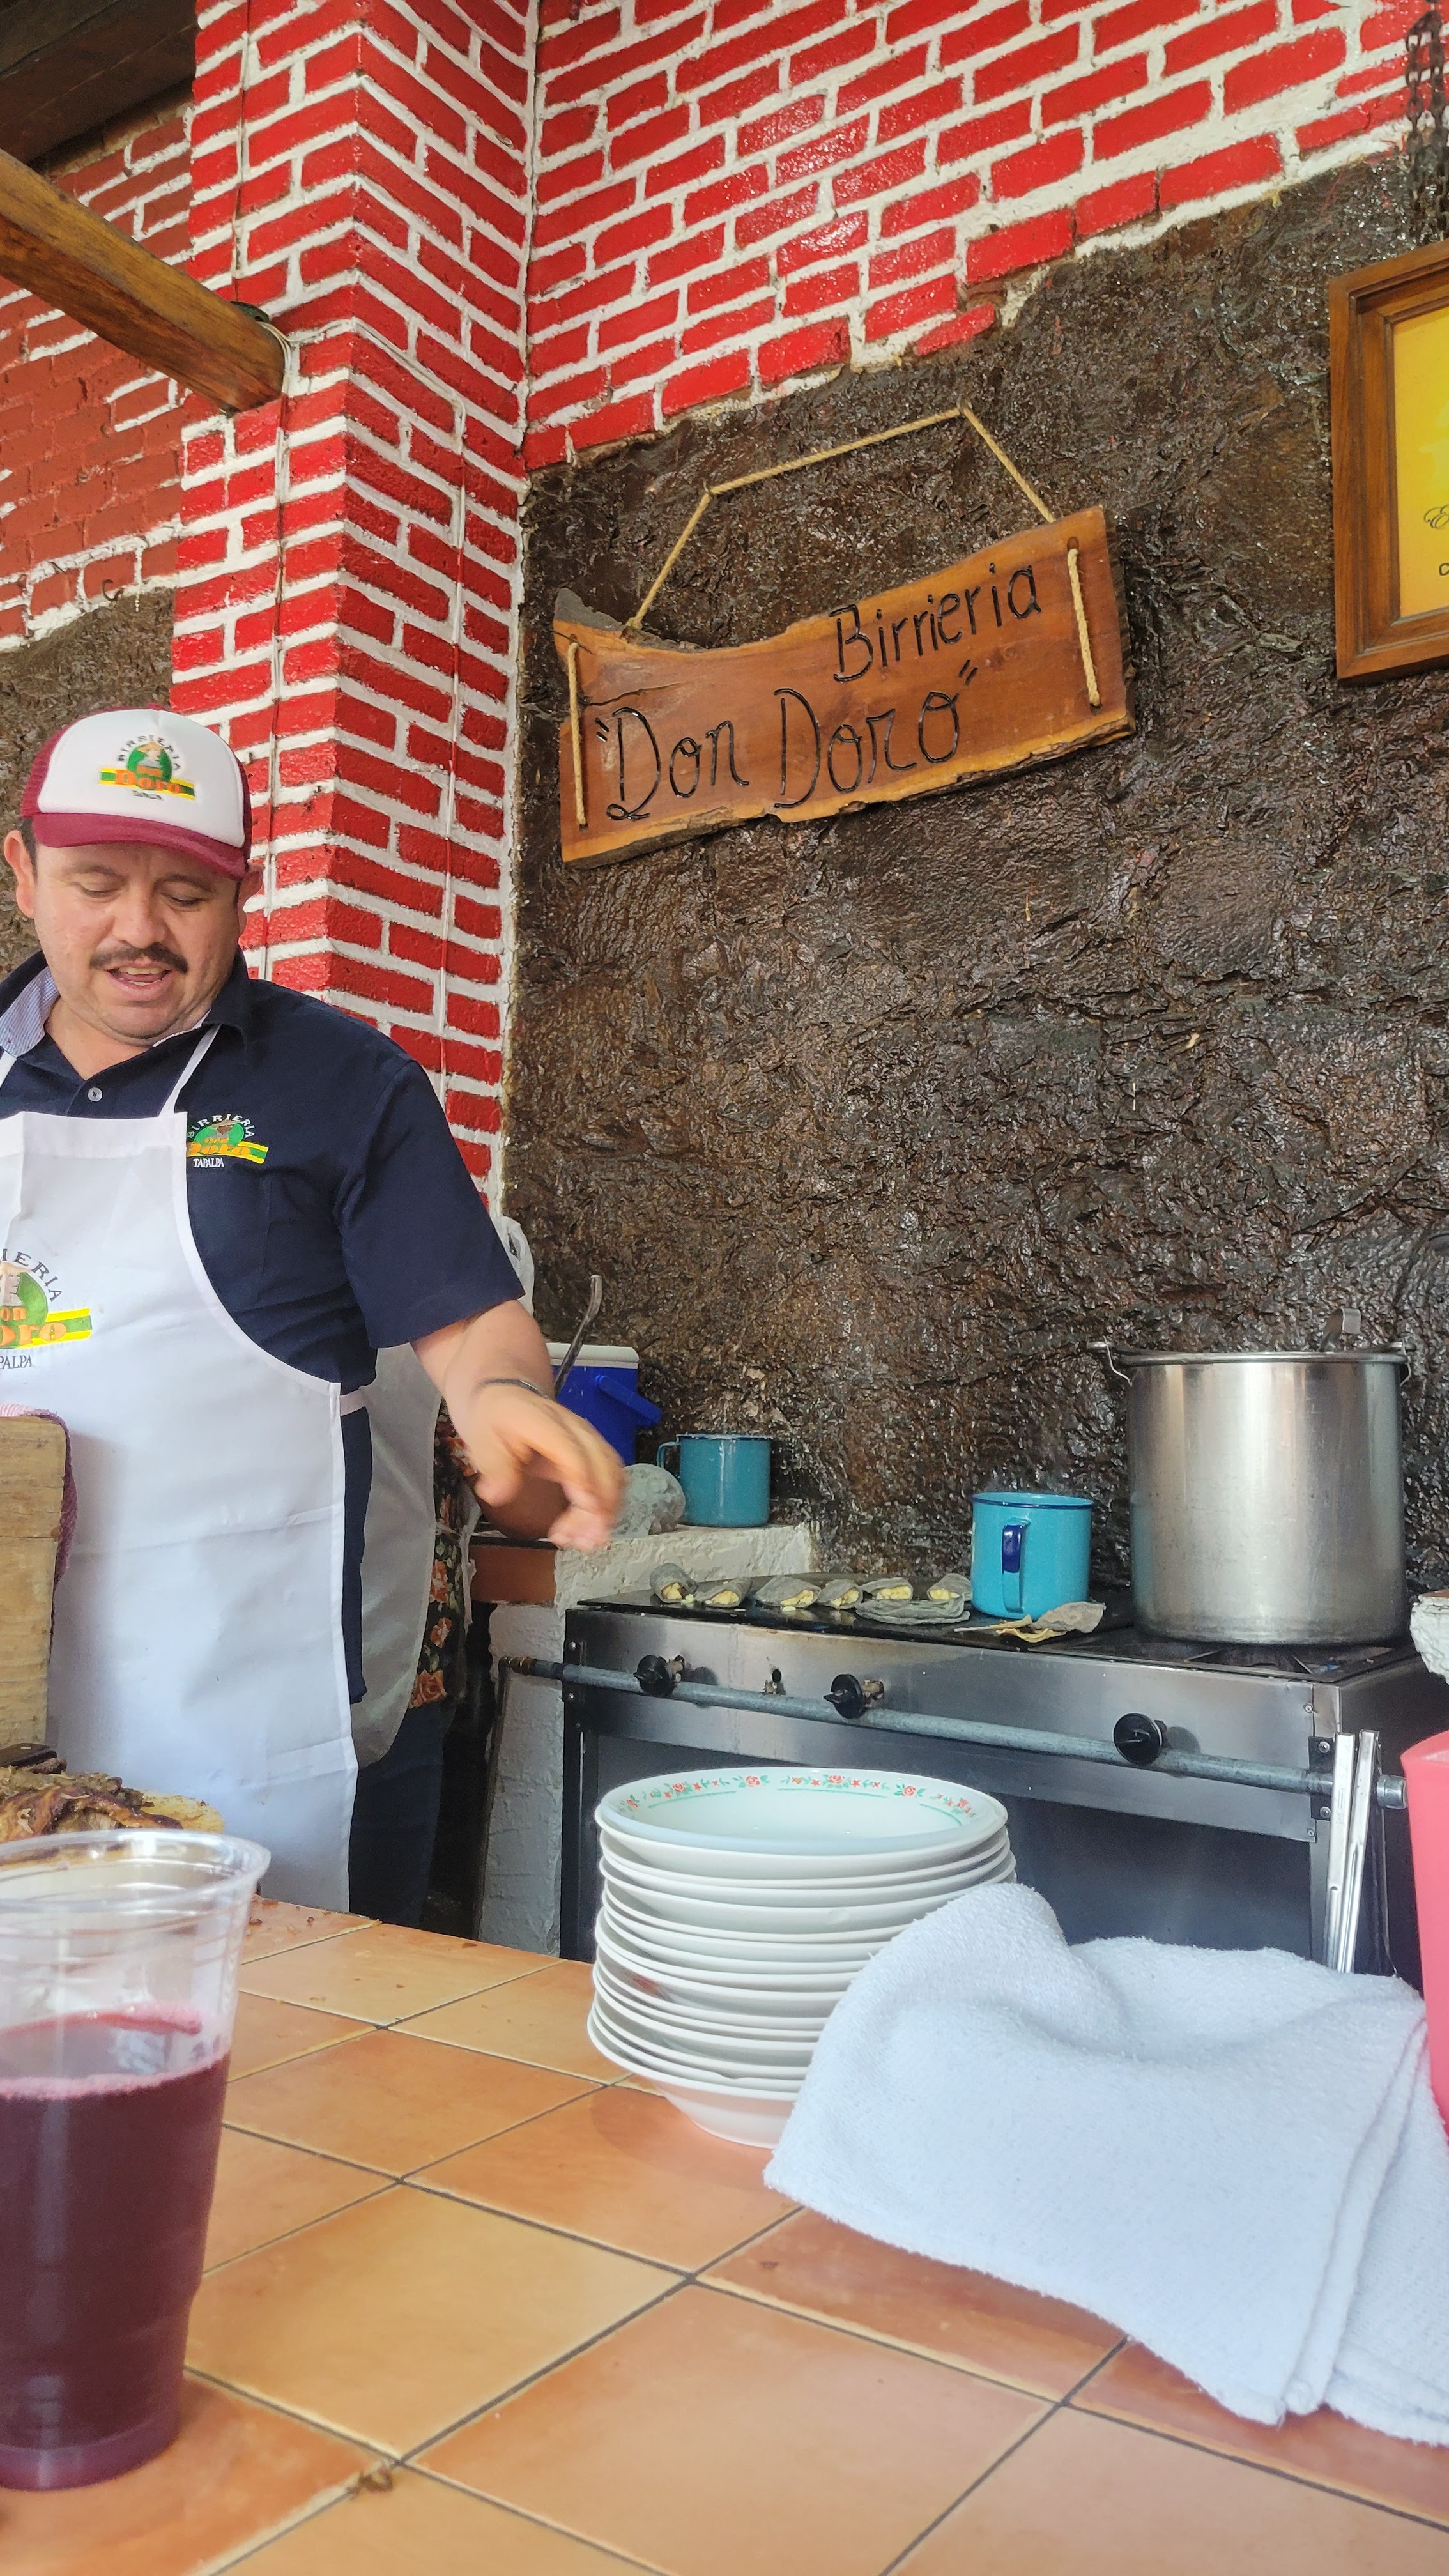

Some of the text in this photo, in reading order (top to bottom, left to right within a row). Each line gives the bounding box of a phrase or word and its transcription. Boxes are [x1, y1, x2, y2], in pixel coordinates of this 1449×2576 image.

[830, 562, 1041, 683] Birrieria
[595, 659, 979, 822] "Don Doro"
[115, 770, 182, 794] Doro
[193, 1157, 224, 1168] TAPALPA
[0, 1248, 62, 1302] IERIA
[0, 1307, 26, 1322] on
[0, 1322, 67, 1346] oro
[0, 1354, 33, 1370] PALPA
